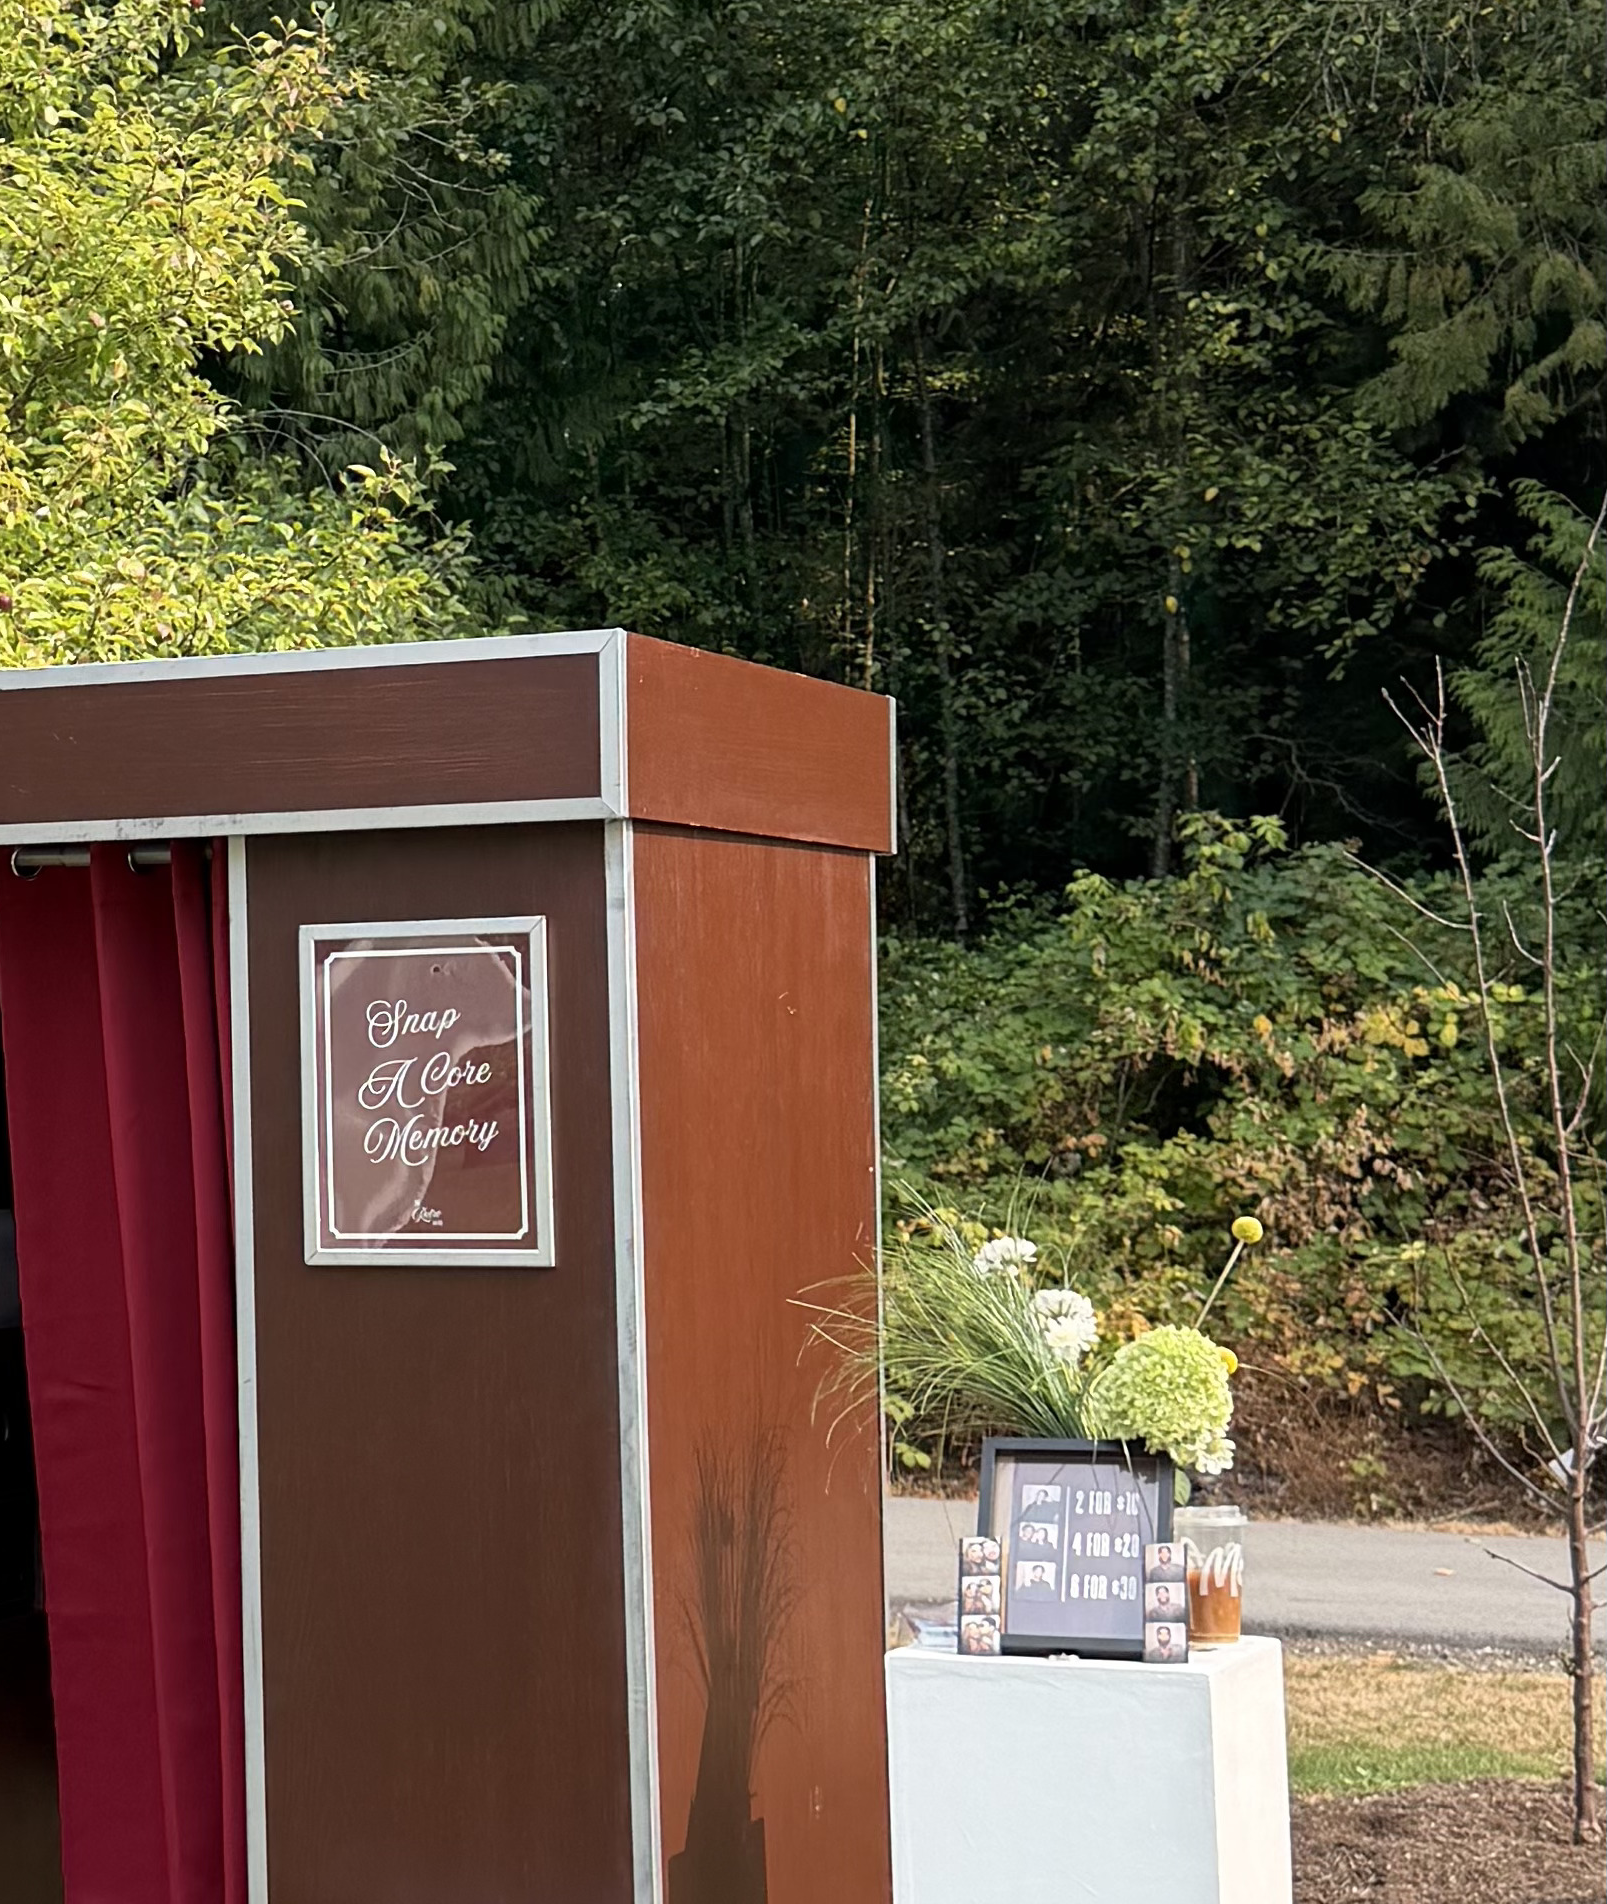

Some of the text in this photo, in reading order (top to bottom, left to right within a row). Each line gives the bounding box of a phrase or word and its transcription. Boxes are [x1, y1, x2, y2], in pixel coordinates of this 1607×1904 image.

[366, 999, 461, 1049] Snap
[358, 1051, 493, 1110] A Core
[363, 1114, 499, 1167] Memory
[1075, 1490, 1084, 1515] 2
[1088, 1490, 1112, 1515] FOR
[1072, 1532, 1140, 1558] 4 FOR $20
[1083, 1574, 1108, 1600] FOR
[1111, 1575, 1137, 1601] $30
